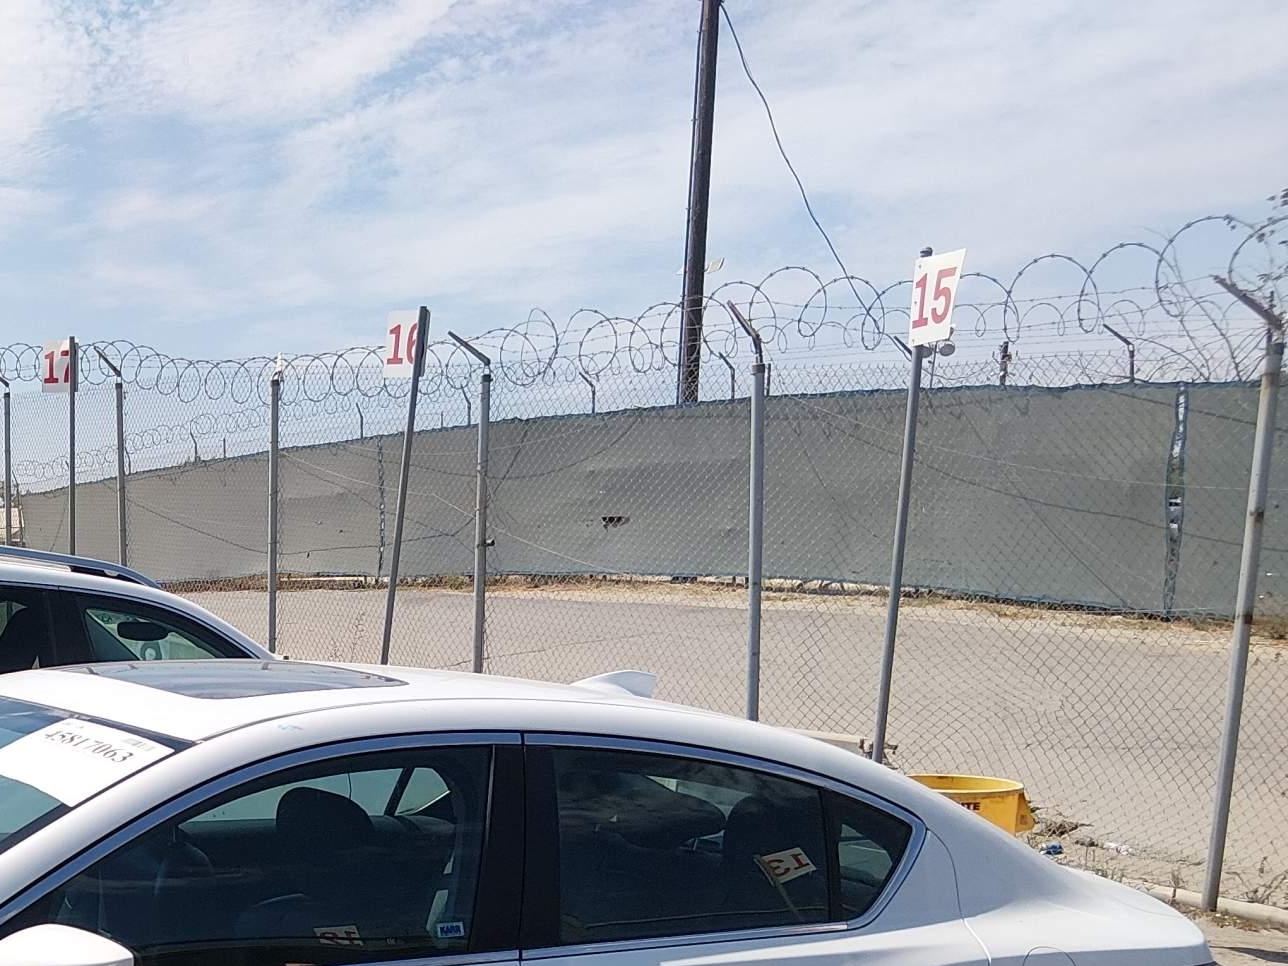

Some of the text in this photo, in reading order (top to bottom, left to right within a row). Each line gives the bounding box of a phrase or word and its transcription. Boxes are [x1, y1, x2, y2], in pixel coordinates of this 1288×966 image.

[911, 267, 957, 329] 15
[44, 350, 70, 384] 17
[44, 729, 134, 763] 45817063
